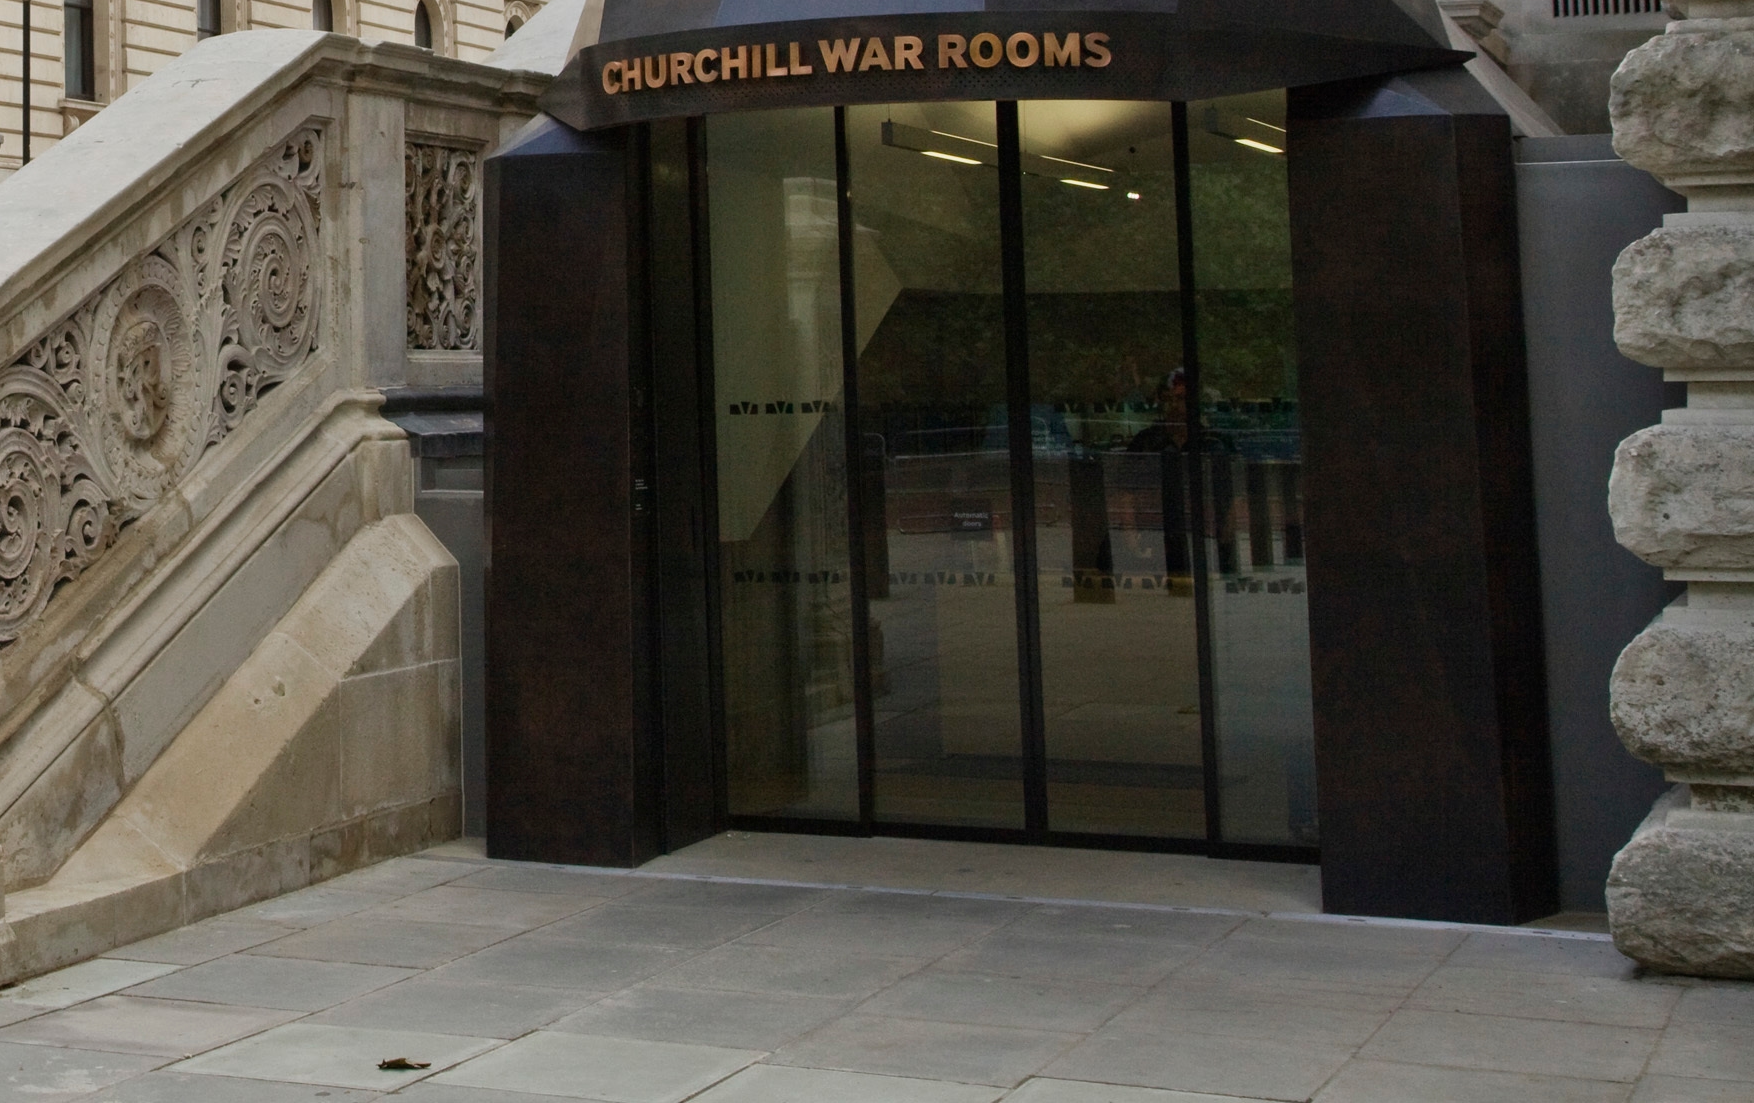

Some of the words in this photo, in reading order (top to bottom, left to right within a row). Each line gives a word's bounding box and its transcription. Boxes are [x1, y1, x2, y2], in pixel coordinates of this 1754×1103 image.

[602, 41, 813, 94] CHURCHILL
[818, 35, 925, 73] WAR
[938, 32, 1112, 68] ROOMS
